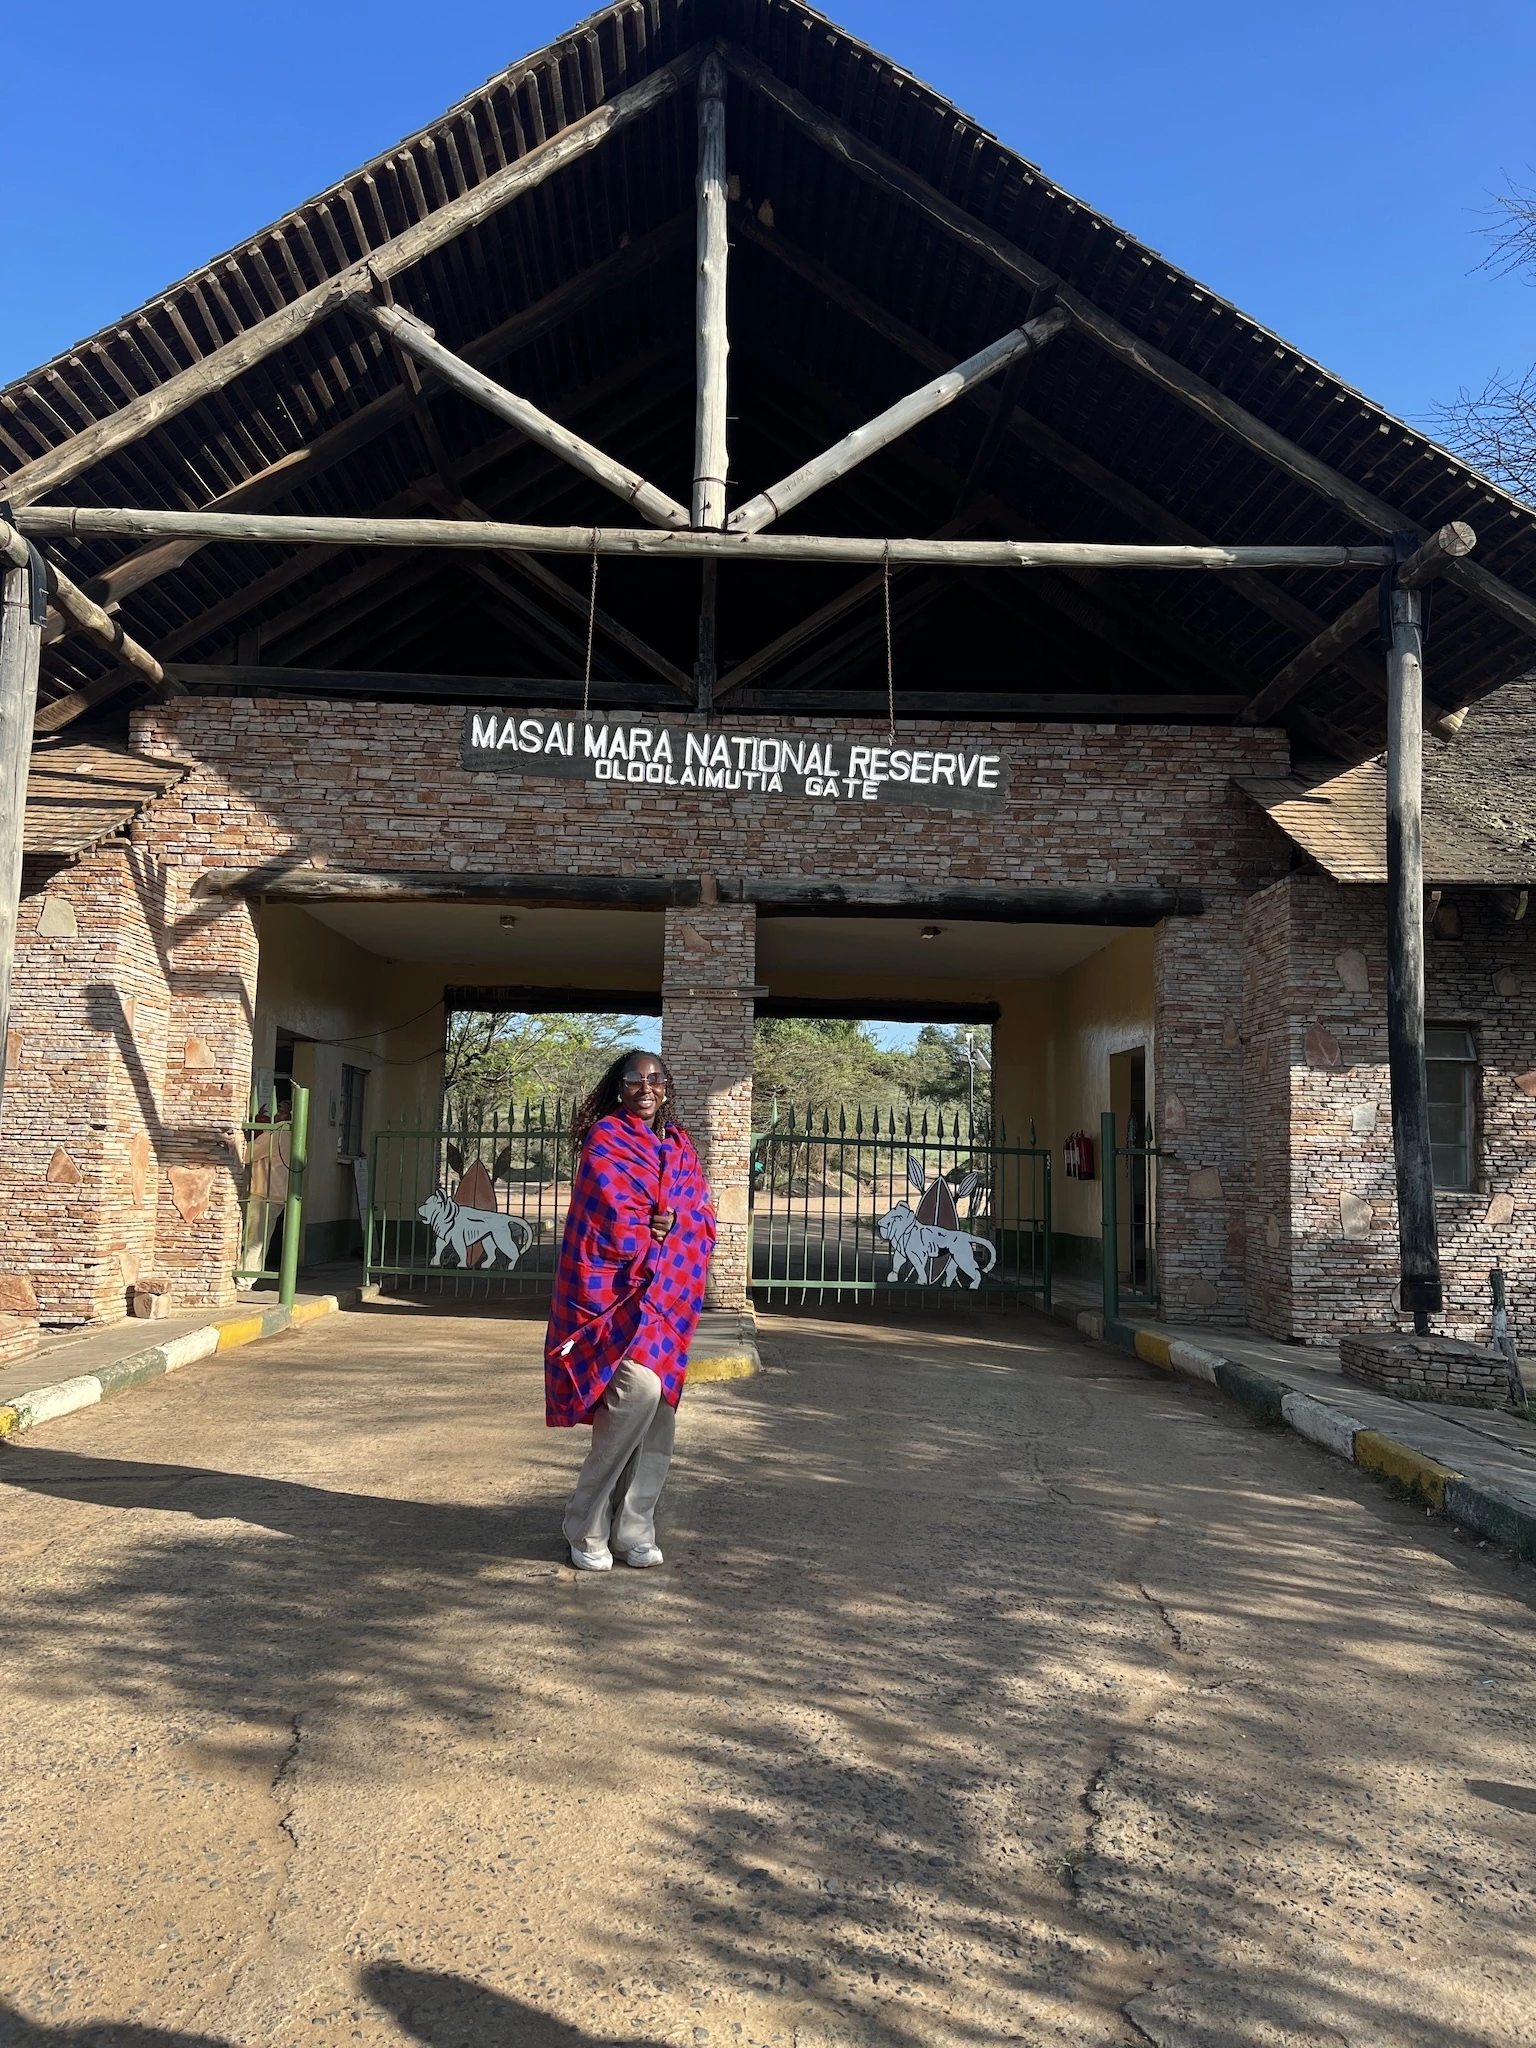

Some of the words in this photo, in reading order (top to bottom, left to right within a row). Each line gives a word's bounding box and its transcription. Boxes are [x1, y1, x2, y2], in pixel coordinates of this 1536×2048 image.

[471, 714, 574, 756] MASAI
[584, 723, 673, 763] MARA
[685, 731, 840, 776] NATIONAL
[848, 745, 1000, 788] RESERVE
[595, 759, 783, 793] OLOOLAIMUTIA
[805, 776, 880, 800] GATE
